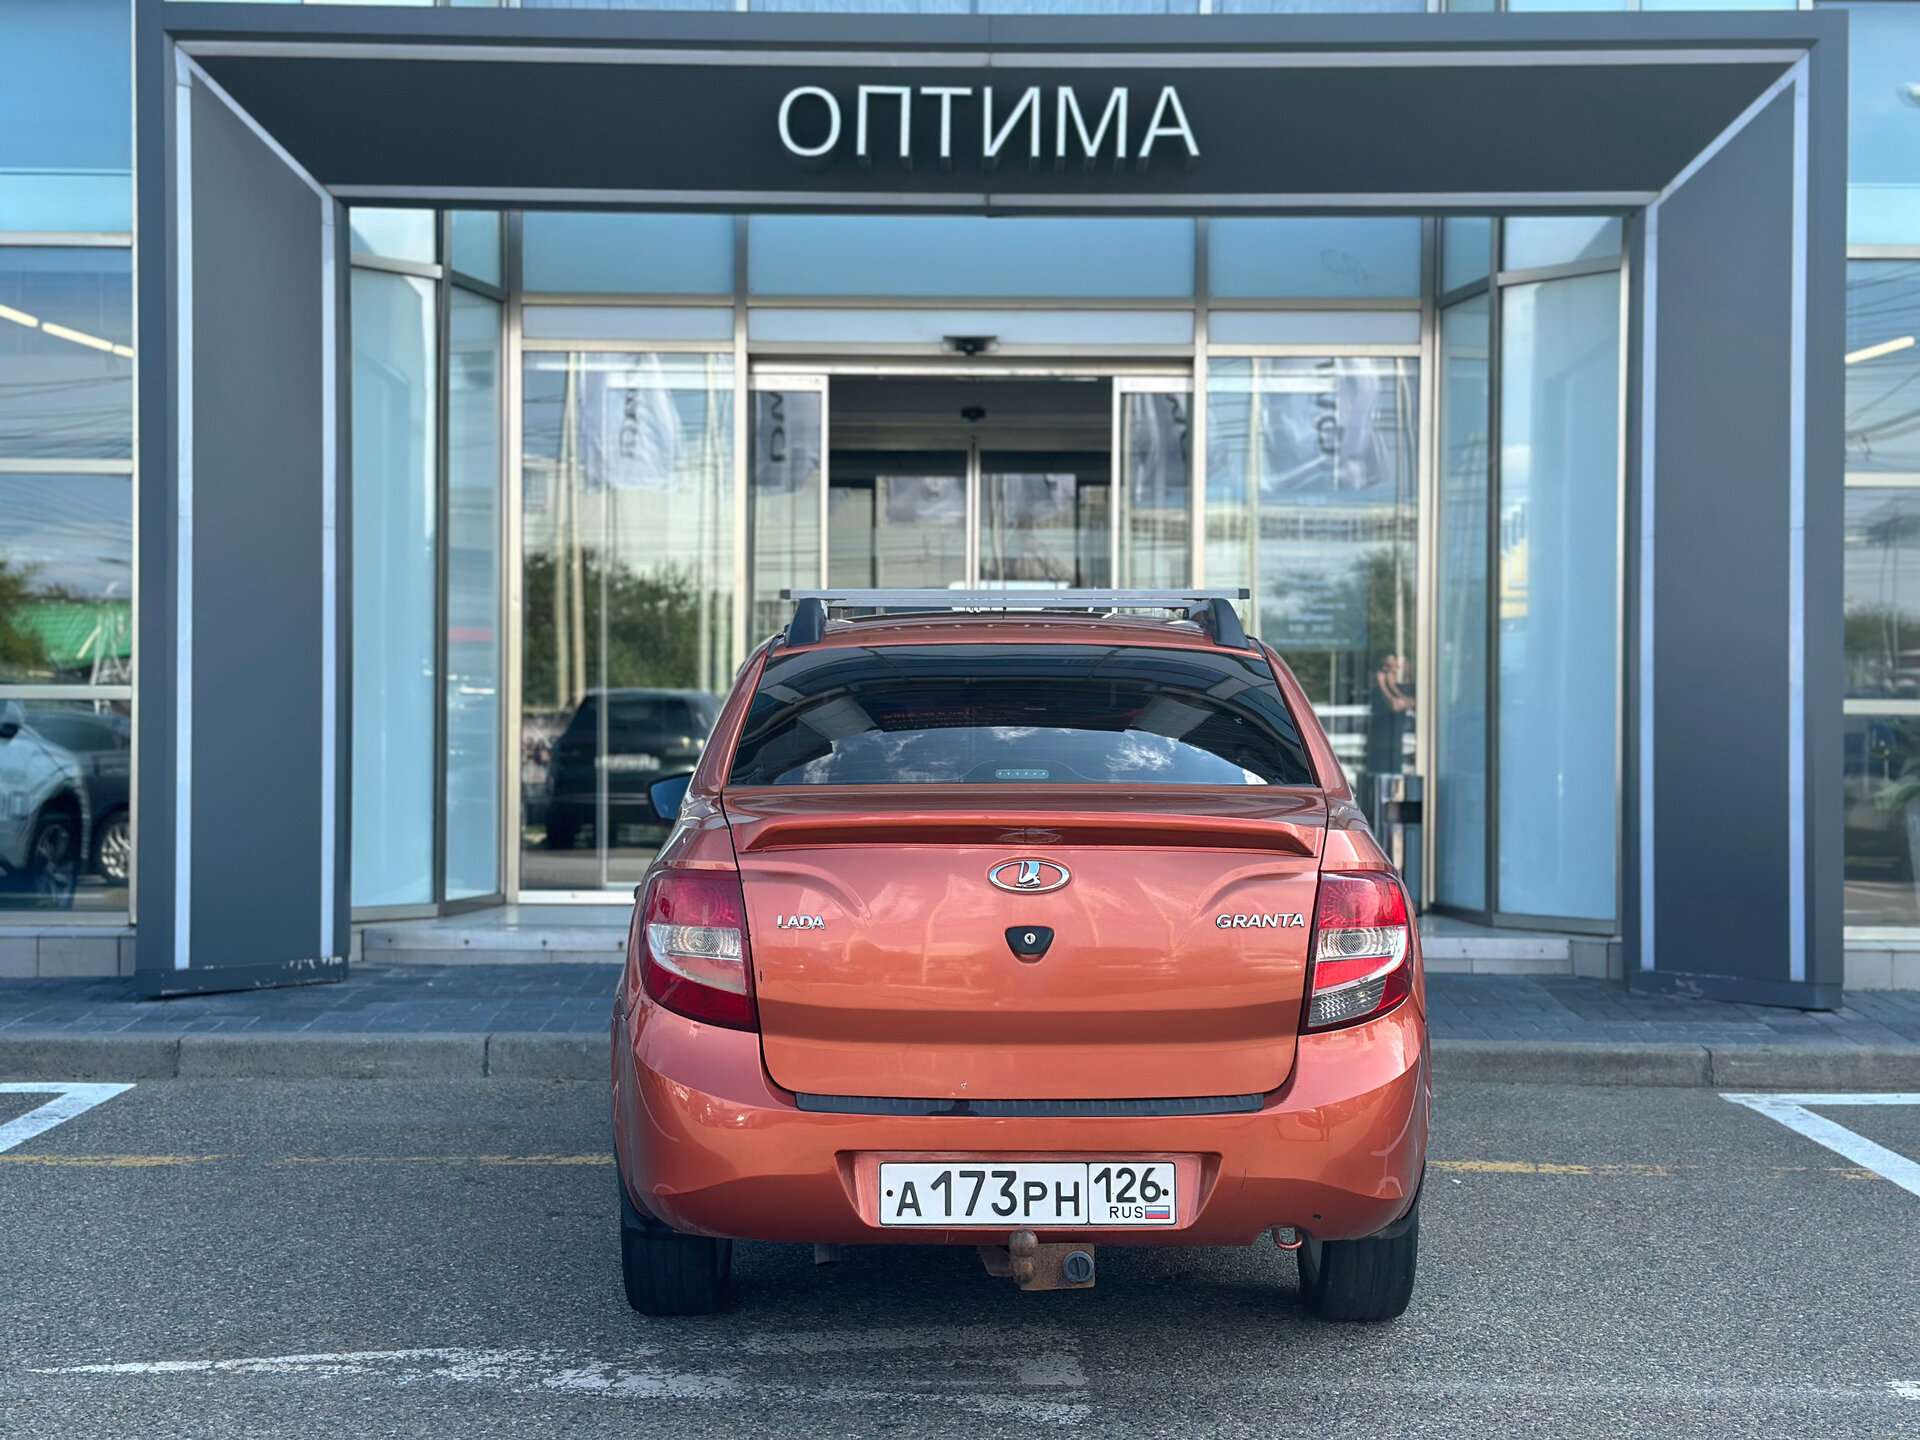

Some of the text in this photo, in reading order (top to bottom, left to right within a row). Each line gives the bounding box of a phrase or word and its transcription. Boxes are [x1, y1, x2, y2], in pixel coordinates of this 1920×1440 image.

[778, 85, 1201, 157] ОПТИМА
[777, 915, 825, 930] LADA
[1216, 913, 1305, 928] GRANTA
[1094, 1167, 1162, 1204] 126
[1109, 1205, 1144, 1219] RUS
